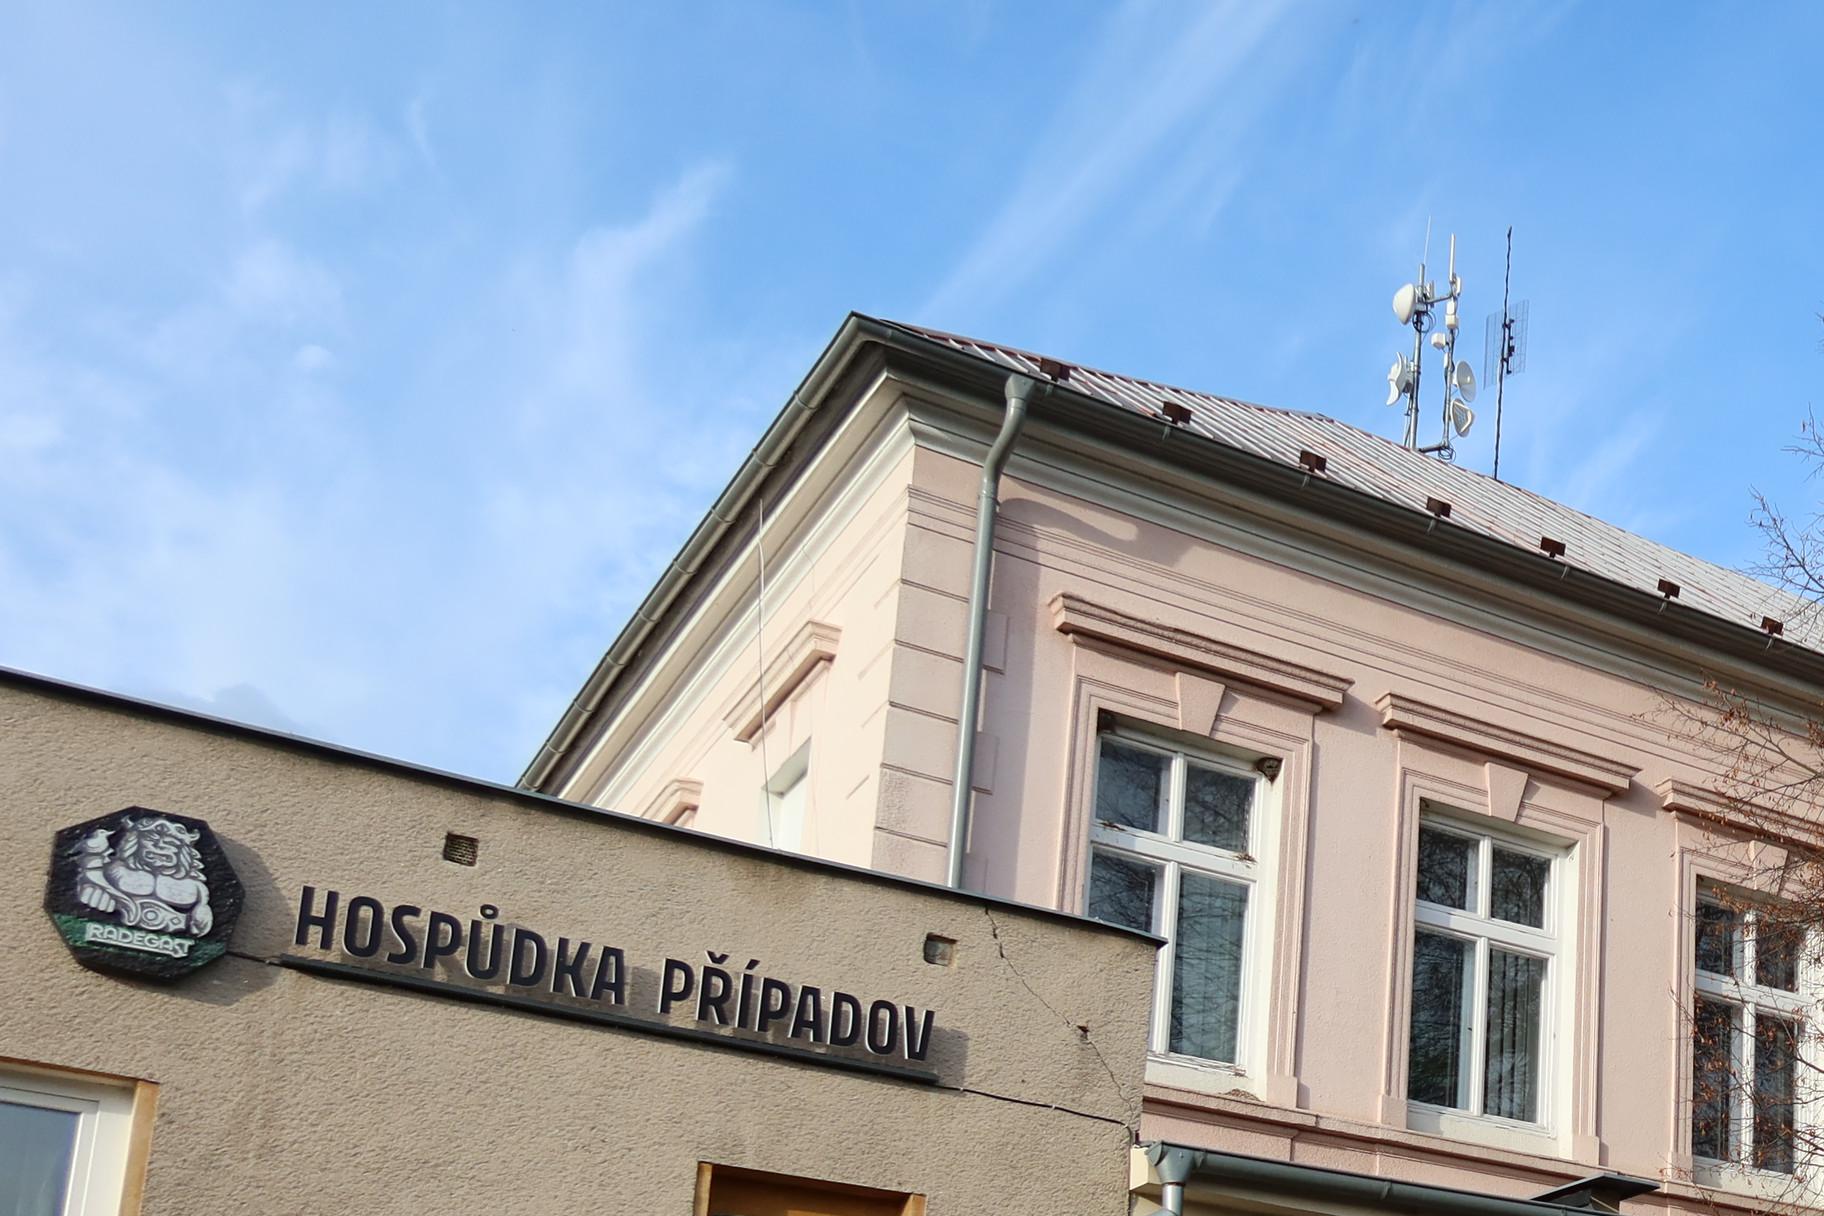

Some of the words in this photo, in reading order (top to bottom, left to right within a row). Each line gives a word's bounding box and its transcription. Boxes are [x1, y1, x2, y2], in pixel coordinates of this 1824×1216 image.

[85, 922, 194, 958] RADEGAST
[294, 885, 625, 1004] HOSPŮDKA
[657, 950, 935, 1061] PŘÍPADOV
